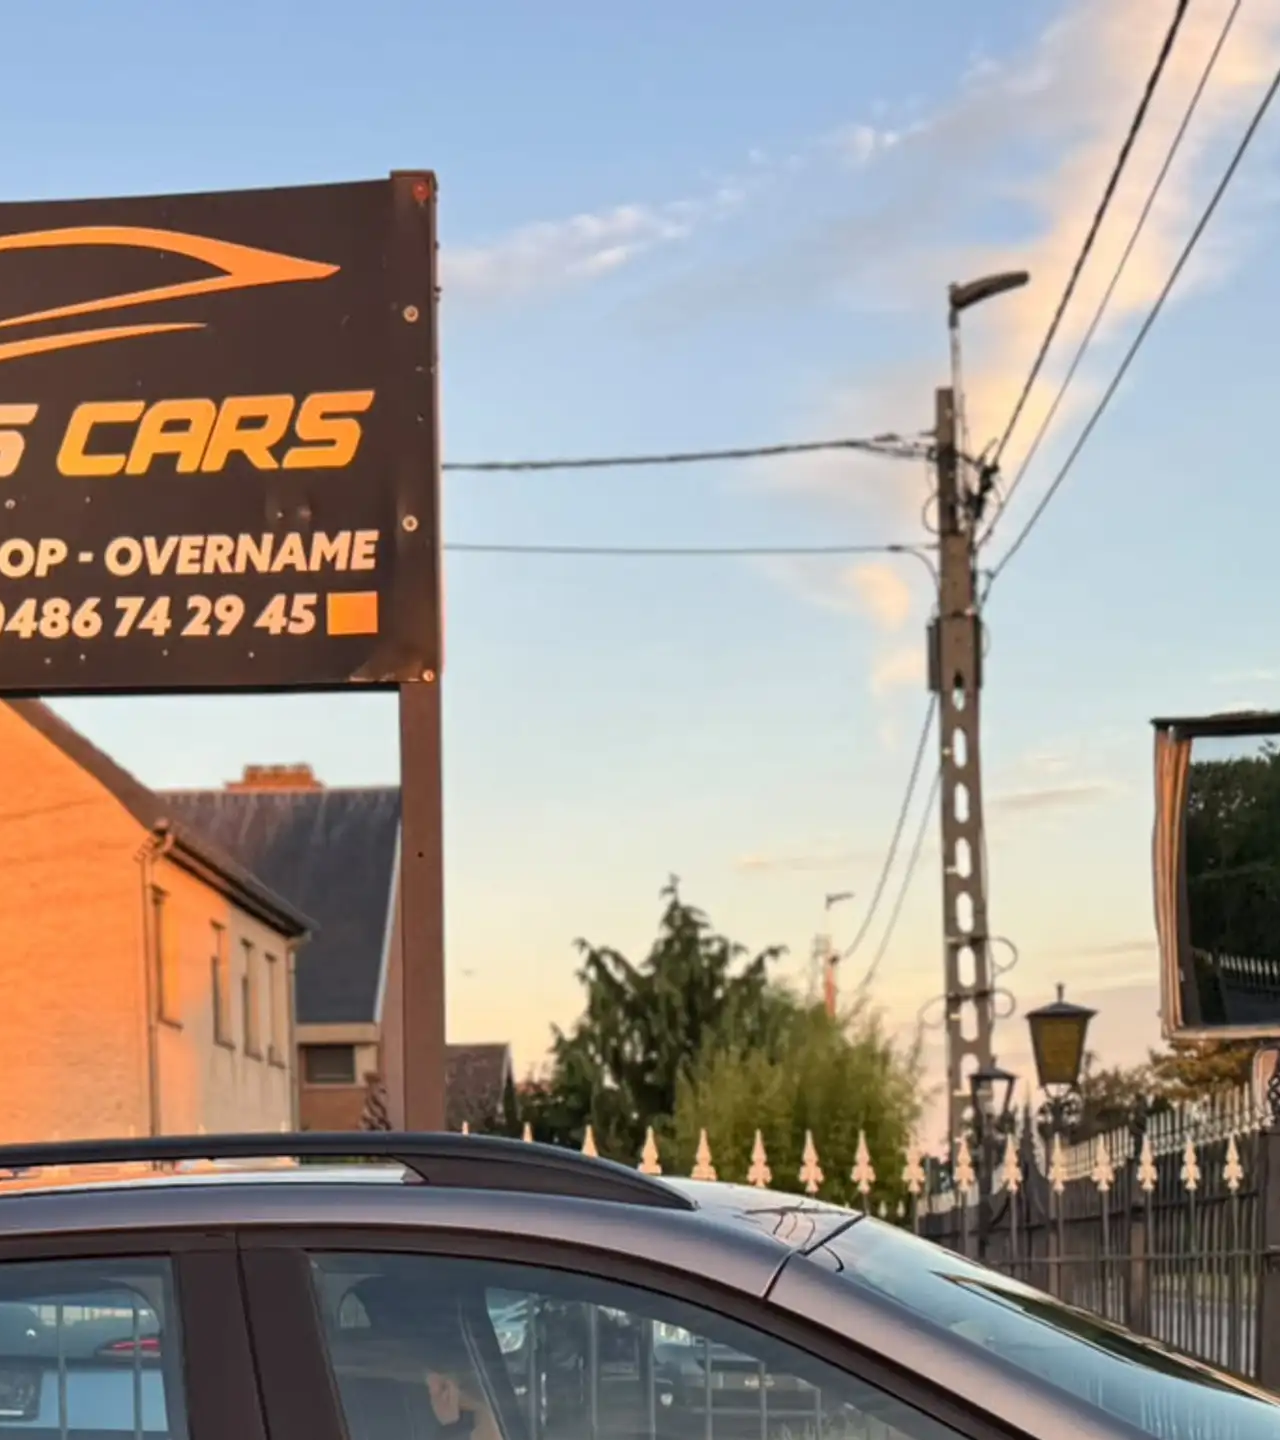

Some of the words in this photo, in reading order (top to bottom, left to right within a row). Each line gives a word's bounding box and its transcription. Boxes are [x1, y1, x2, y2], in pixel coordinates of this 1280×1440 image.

[55, 390, 376, 477] CARS
[104, 530, 379, 577] OVERNAME
[114, 595, 172, 637] 74
[180, 594, 245, 637] 29
[253, 593, 318, 635] 45
